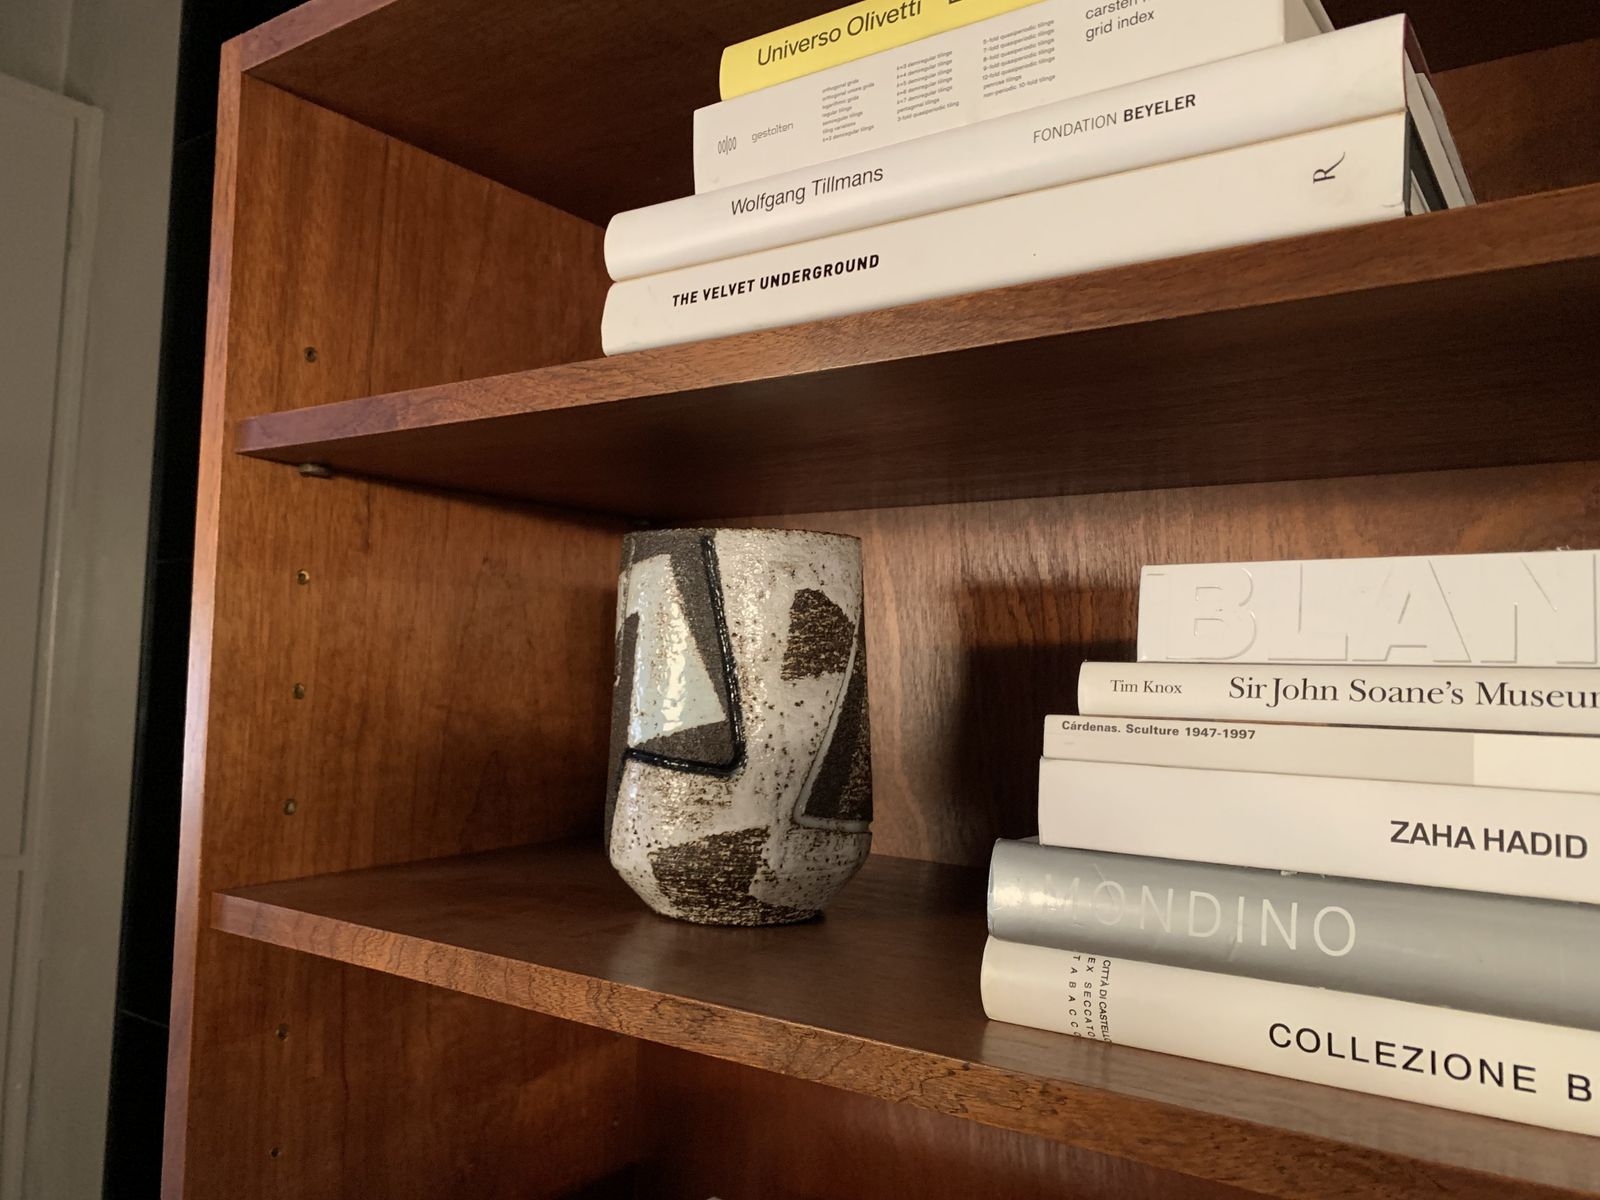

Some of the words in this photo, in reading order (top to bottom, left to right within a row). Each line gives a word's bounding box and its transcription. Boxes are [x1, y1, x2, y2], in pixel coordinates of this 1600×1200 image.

[757, 27, 842, 66] Universo
[847, 0, 921, 36] Olivetti
[1085, 19, 1112, 42] grid
[1118, 10, 1154, 29] index
[1033, 112, 1117, 143] FONDATION
[1123, 94, 1196, 122] BEYELER
[731, 187, 805, 215] Wolfgang
[811, 168, 884, 196] Tillmans
[672, 290, 699, 307] THE
[703, 279, 756, 301] VELVET
[760, 254, 880, 290] UNDERGROUND
[1110, 679, 1138, 693] Tim
[1143, 680, 1183, 694] Knox
[1229, 676, 1268, 699] Sir
[1266, 678, 1339, 708] John
[1349, 679, 1464, 705] Soane's
[1062, 720, 1121, 733] Cárdenas.
[1126, 724, 1179, 736] Sculture
[1185, 727, 1256, 740] 1947-1997
[1390, 820, 1476, 850] ZAHA
[1483, 828, 1588, 859] HADID
[1044, 873, 1356, 957] MONDINO
[1086, 957, 1096, 973] EX
[1099, 989, 1108, 1000] DI
[1269, 1023, 1537, 1094] COLLEZIONE
